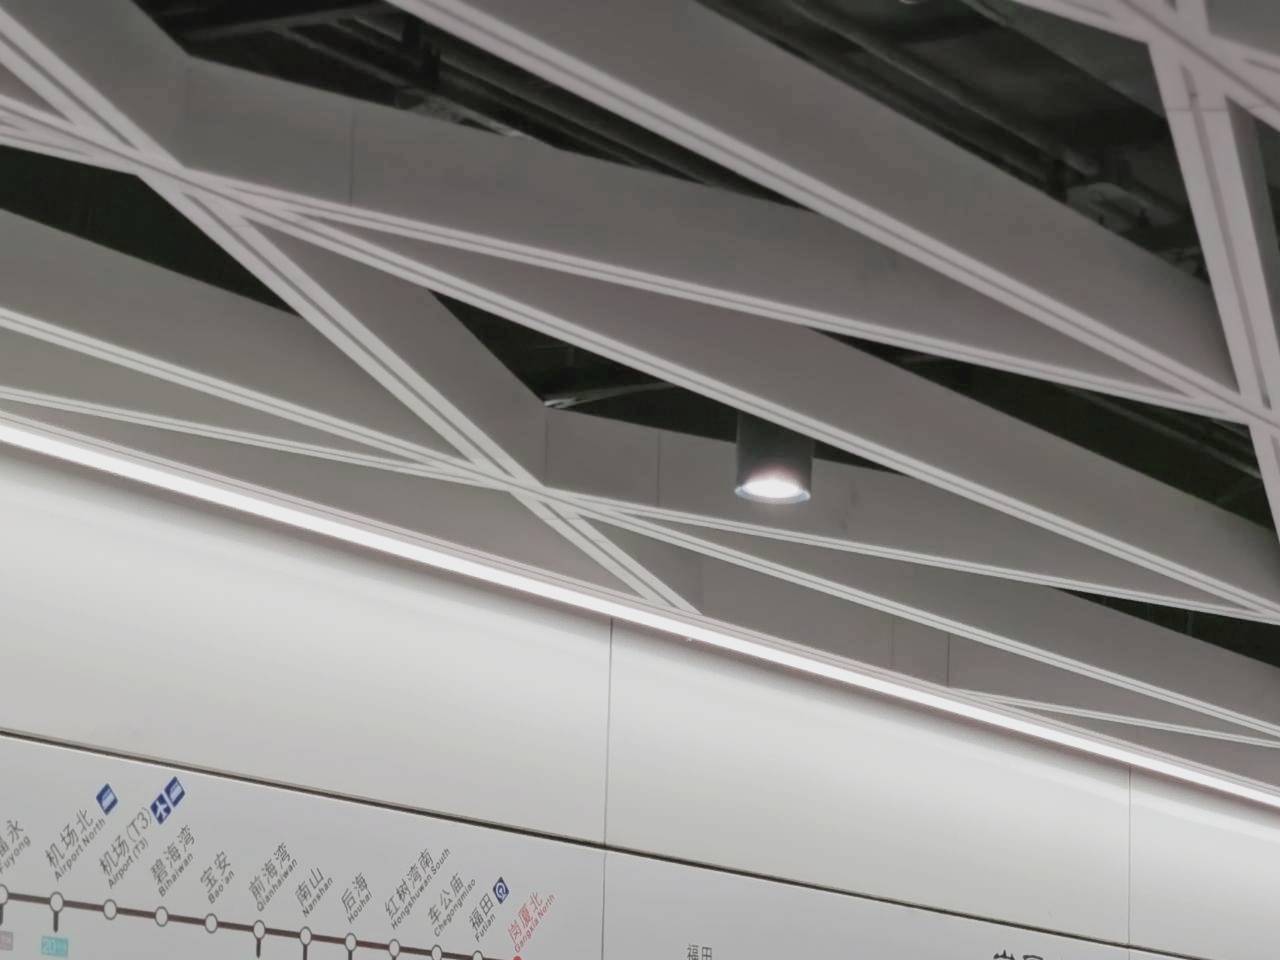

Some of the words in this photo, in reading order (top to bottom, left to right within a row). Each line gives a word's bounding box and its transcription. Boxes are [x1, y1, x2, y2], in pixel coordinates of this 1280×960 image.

[45, 809, 93, 868] 机场北
[55, 845, 84, 881] Airport
[82, 818, 105, 847] North
[151, 825, 195, 885] 碧海湾
[108, 856, 133, 889] Airport
[158, 853, 193, 897] Bihaiwan
[200, 851, 231, 893] 宝安
[248, 843, 291, 900] 前海湾
[257, 858, 297, 911] Qianhaiwan
[295, 867, 324, 907] 南山
[302, 877, 333, 917] Nanshan
[341, 872, 372, 914] 后海
[385, 848, 433, 920] 红树湾南
[391, 873, 432, 930] Hongshuwan
[430, 848, 450, 875] South
[428, 872, 464, 925] 车公庙
[434, 879, 476, 937] Chegongmiao
[469, 893, 494, 932] 福田
[475, 913, 496, 942] Futian
